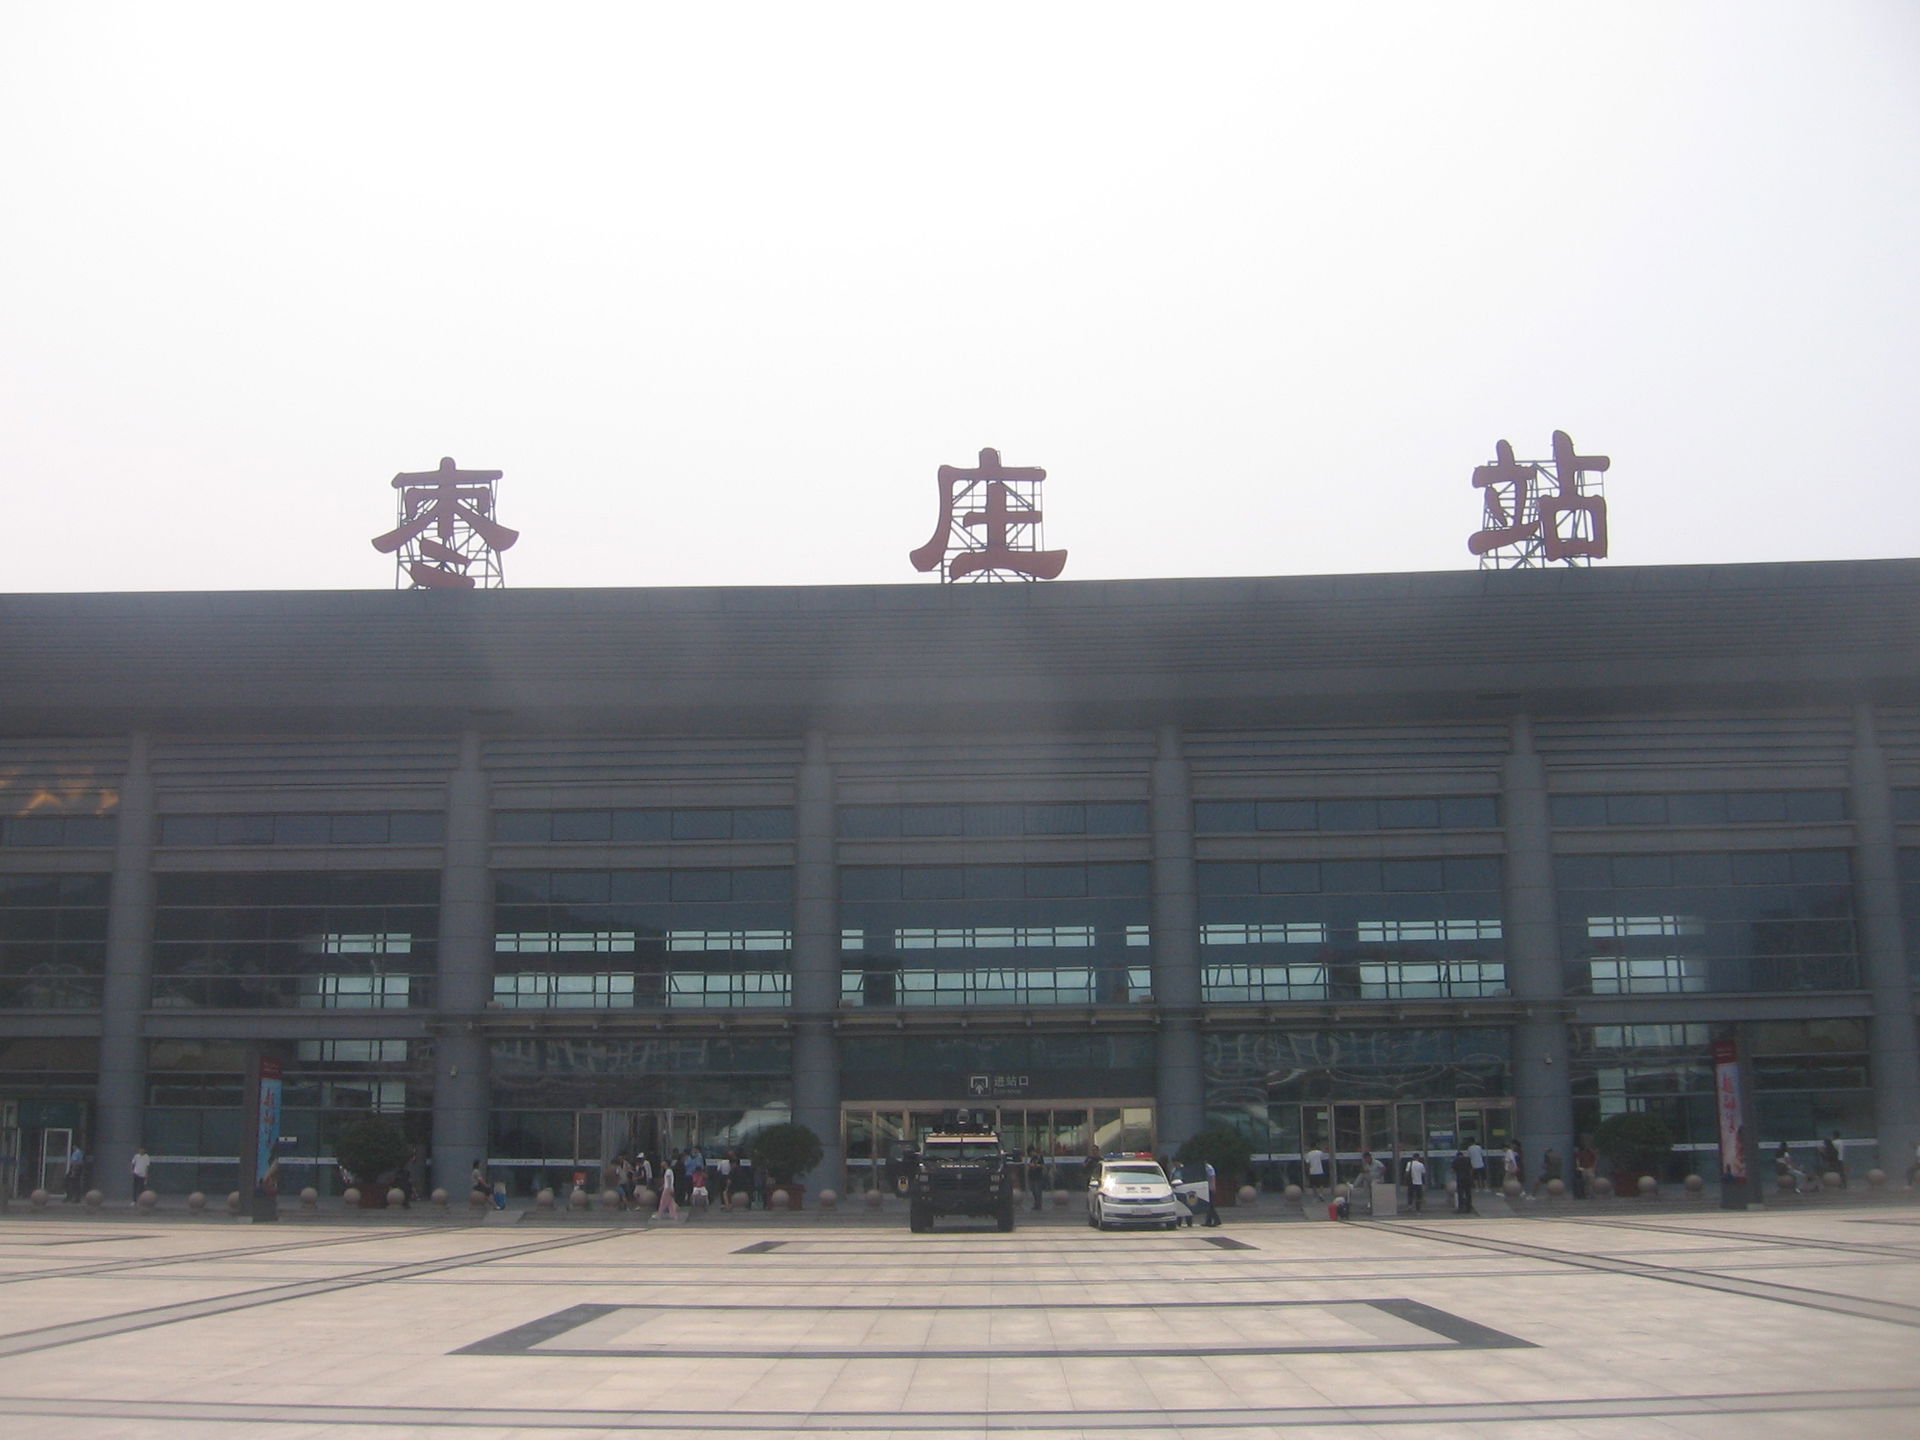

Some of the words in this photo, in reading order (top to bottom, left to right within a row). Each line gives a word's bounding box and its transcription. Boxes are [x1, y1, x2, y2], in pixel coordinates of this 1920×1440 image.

[371, 430, 1608, 588] 枣庄站
[994, 1076, 1029, 1087] 进站口
